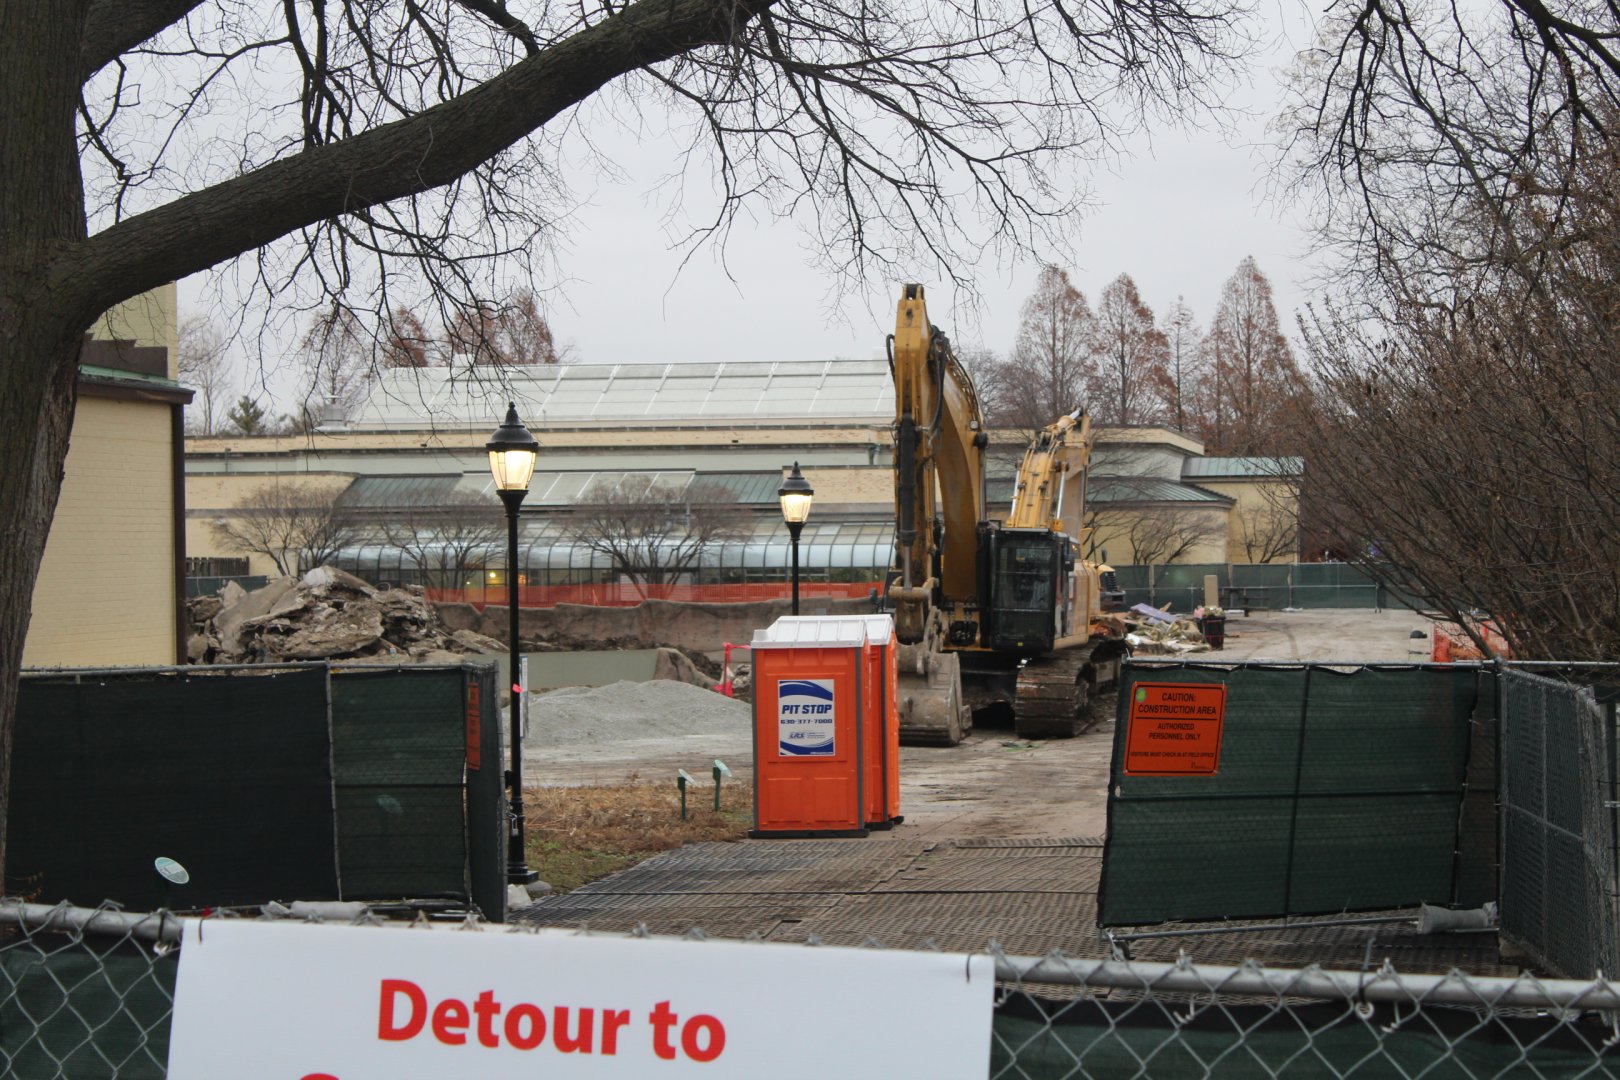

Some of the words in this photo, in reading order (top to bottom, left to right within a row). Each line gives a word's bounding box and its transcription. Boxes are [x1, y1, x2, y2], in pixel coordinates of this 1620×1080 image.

[1162, 693, 1196, 701] CAUTION:
[782, 705, 800, 714] PIT
[802, 704, 832, 714] STOP
[1138, 705, 1195, 714] CONSTRUCTION
[1197, 706, 1216, 714] AREA
[1185, 733, 1200, 741] ONLY
[379, 979, 631, 1056] Detour
[649, 1001, 726, 1063] to
